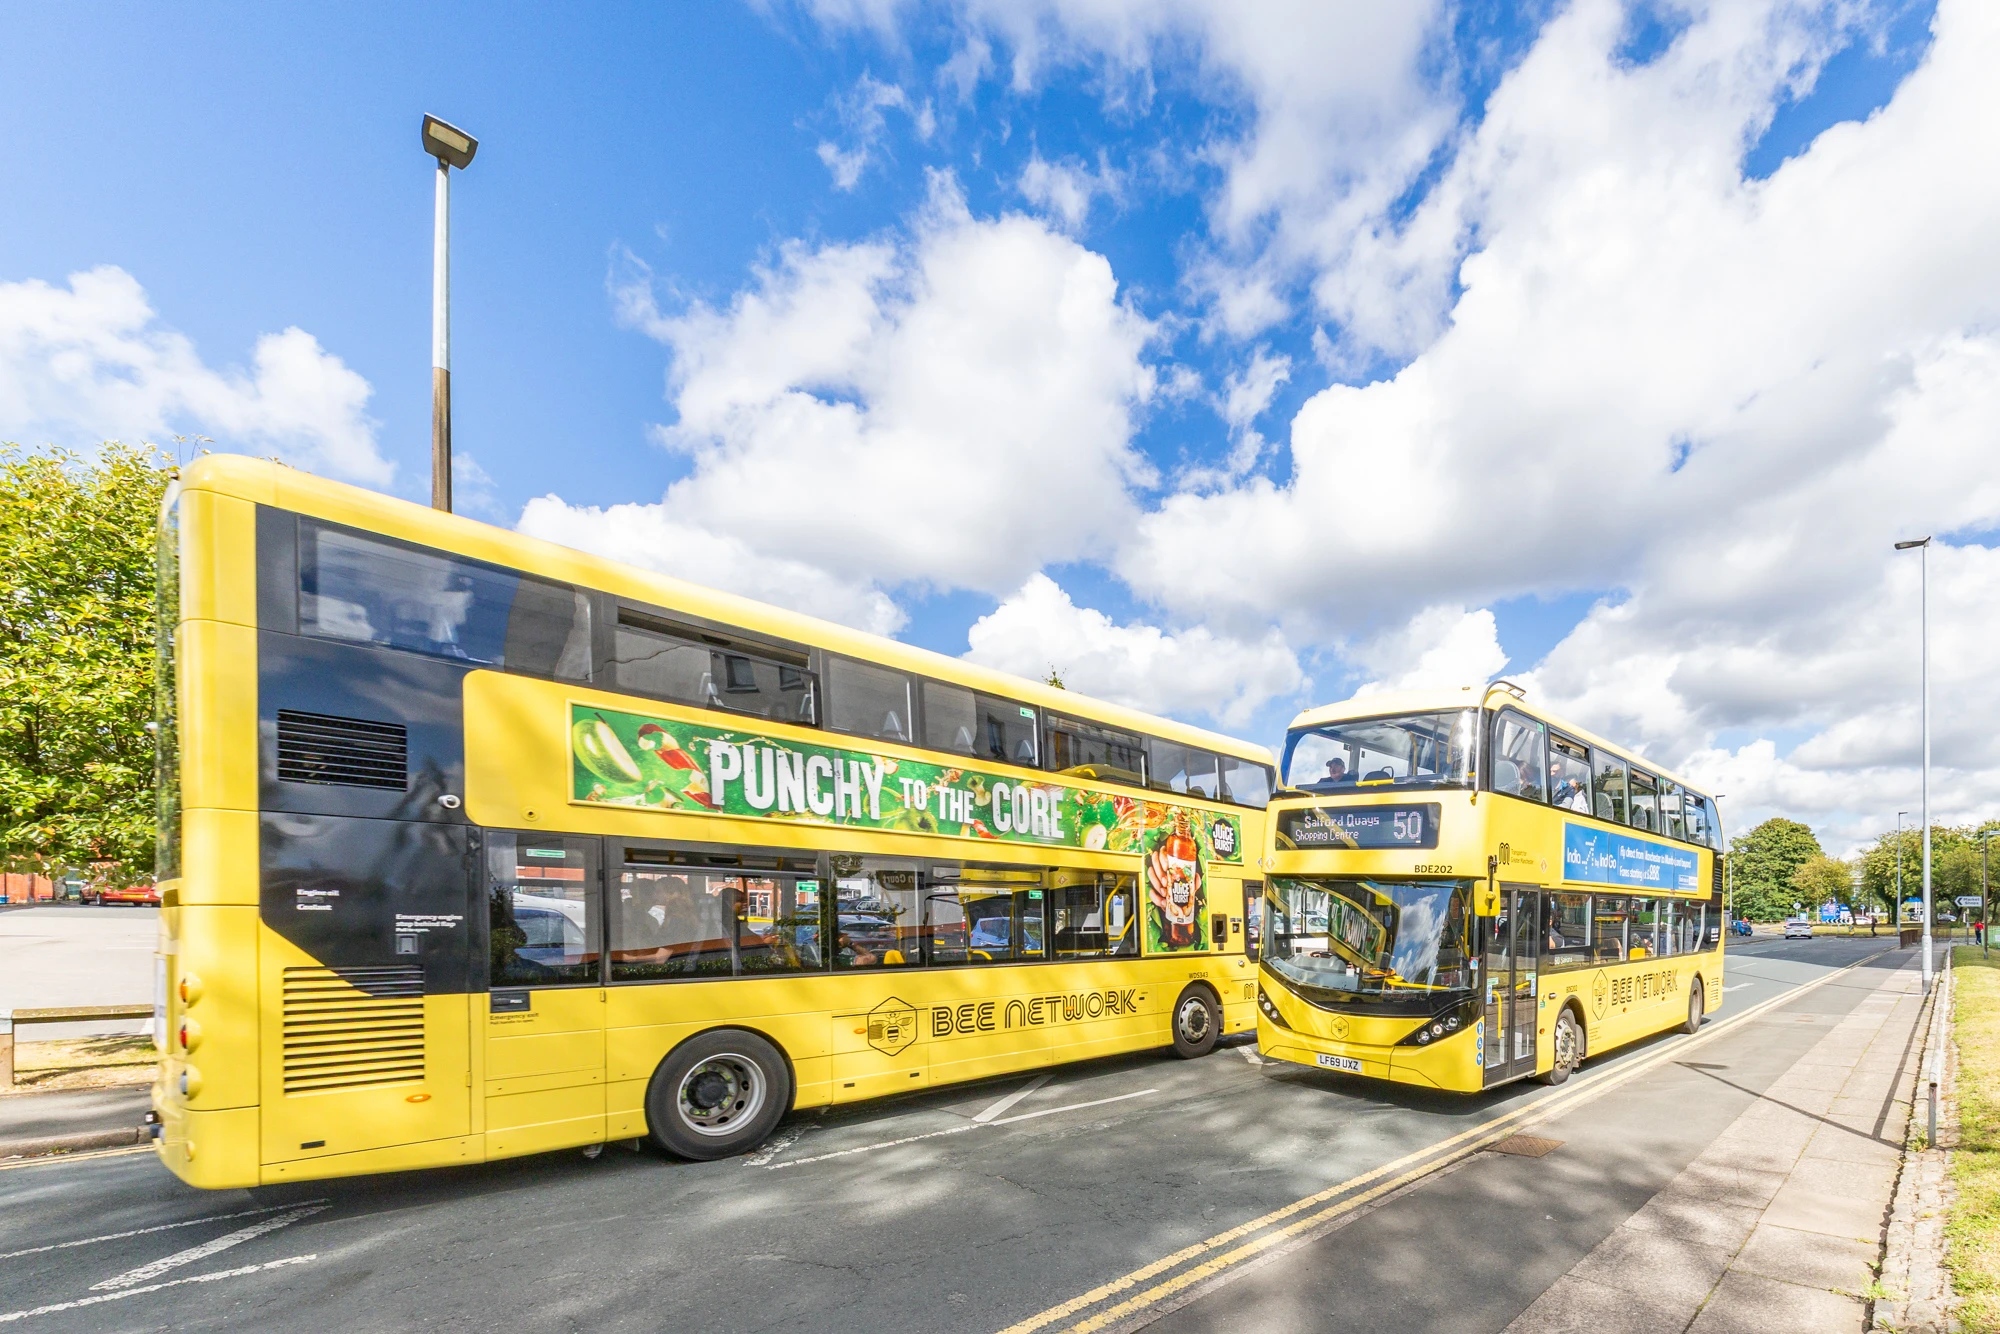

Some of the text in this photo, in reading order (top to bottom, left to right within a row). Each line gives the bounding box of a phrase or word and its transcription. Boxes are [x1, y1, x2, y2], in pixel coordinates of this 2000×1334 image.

[709, 740, 1065, 839] PUNCHY TO THE CORE
[1304, 813, 1380, 829] Salford Quays
[1393, 811, 1422, 840] 50
[1295, 828, 1360, 842] Shopping Centre
[1214, 839, 1235, 853] BURST
[1414, 864, 1453, 874] BDE202
[1600, 852, 1617, 869] IndGo
[1611, 968, 1678, 1006] BEE NETWORK
[932, 988, 1137, 1038] BEE NETWORK
[1319, 1054, 1359, 1071] LF69 UXZ
